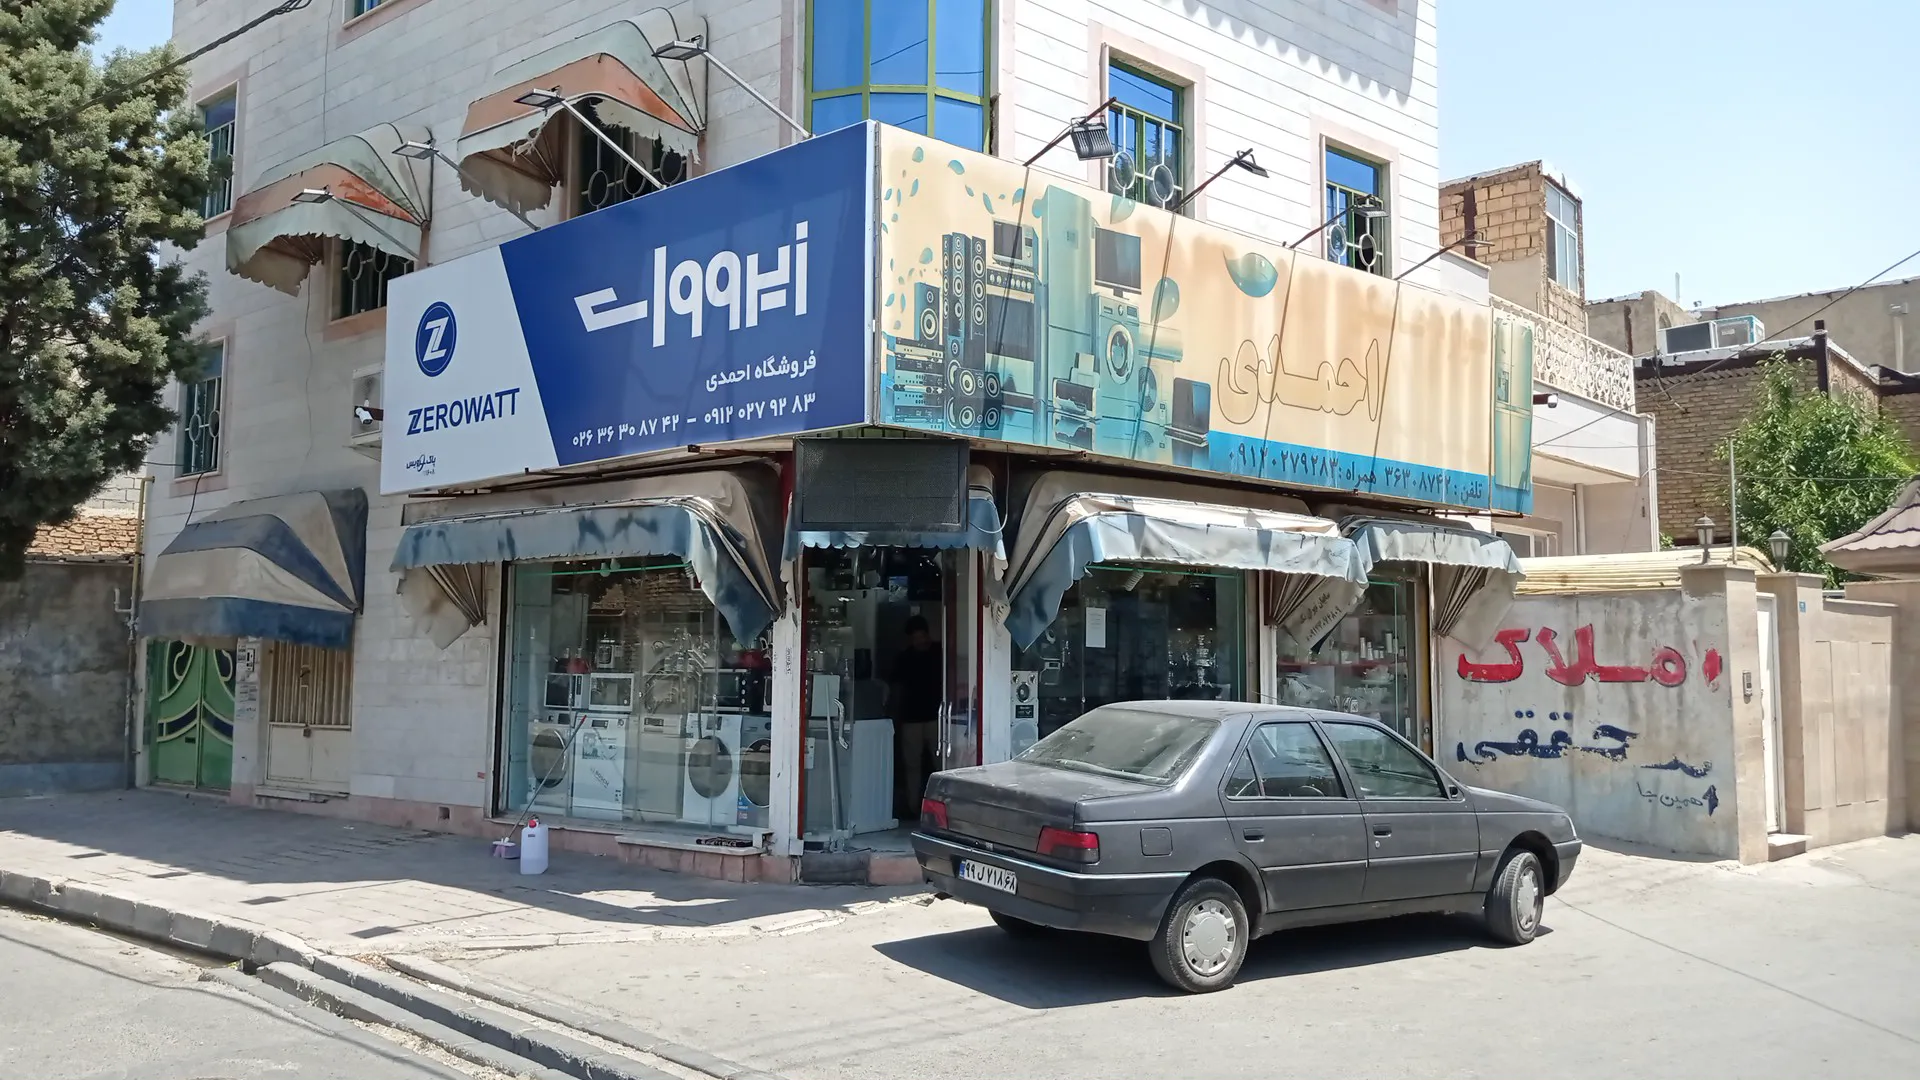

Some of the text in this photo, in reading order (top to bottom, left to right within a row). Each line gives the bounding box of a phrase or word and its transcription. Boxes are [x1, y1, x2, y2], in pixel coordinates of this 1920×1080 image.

[706, 349, 817, 392] فروشگاه احمدی
[1217, 334, 1379, 424] احمدی
[407, 387, 520, 436] ZEROWATT
[704, 405, 734, 425] ۰۹۱۲
[1636, 781, 1704, 809] همین جا
